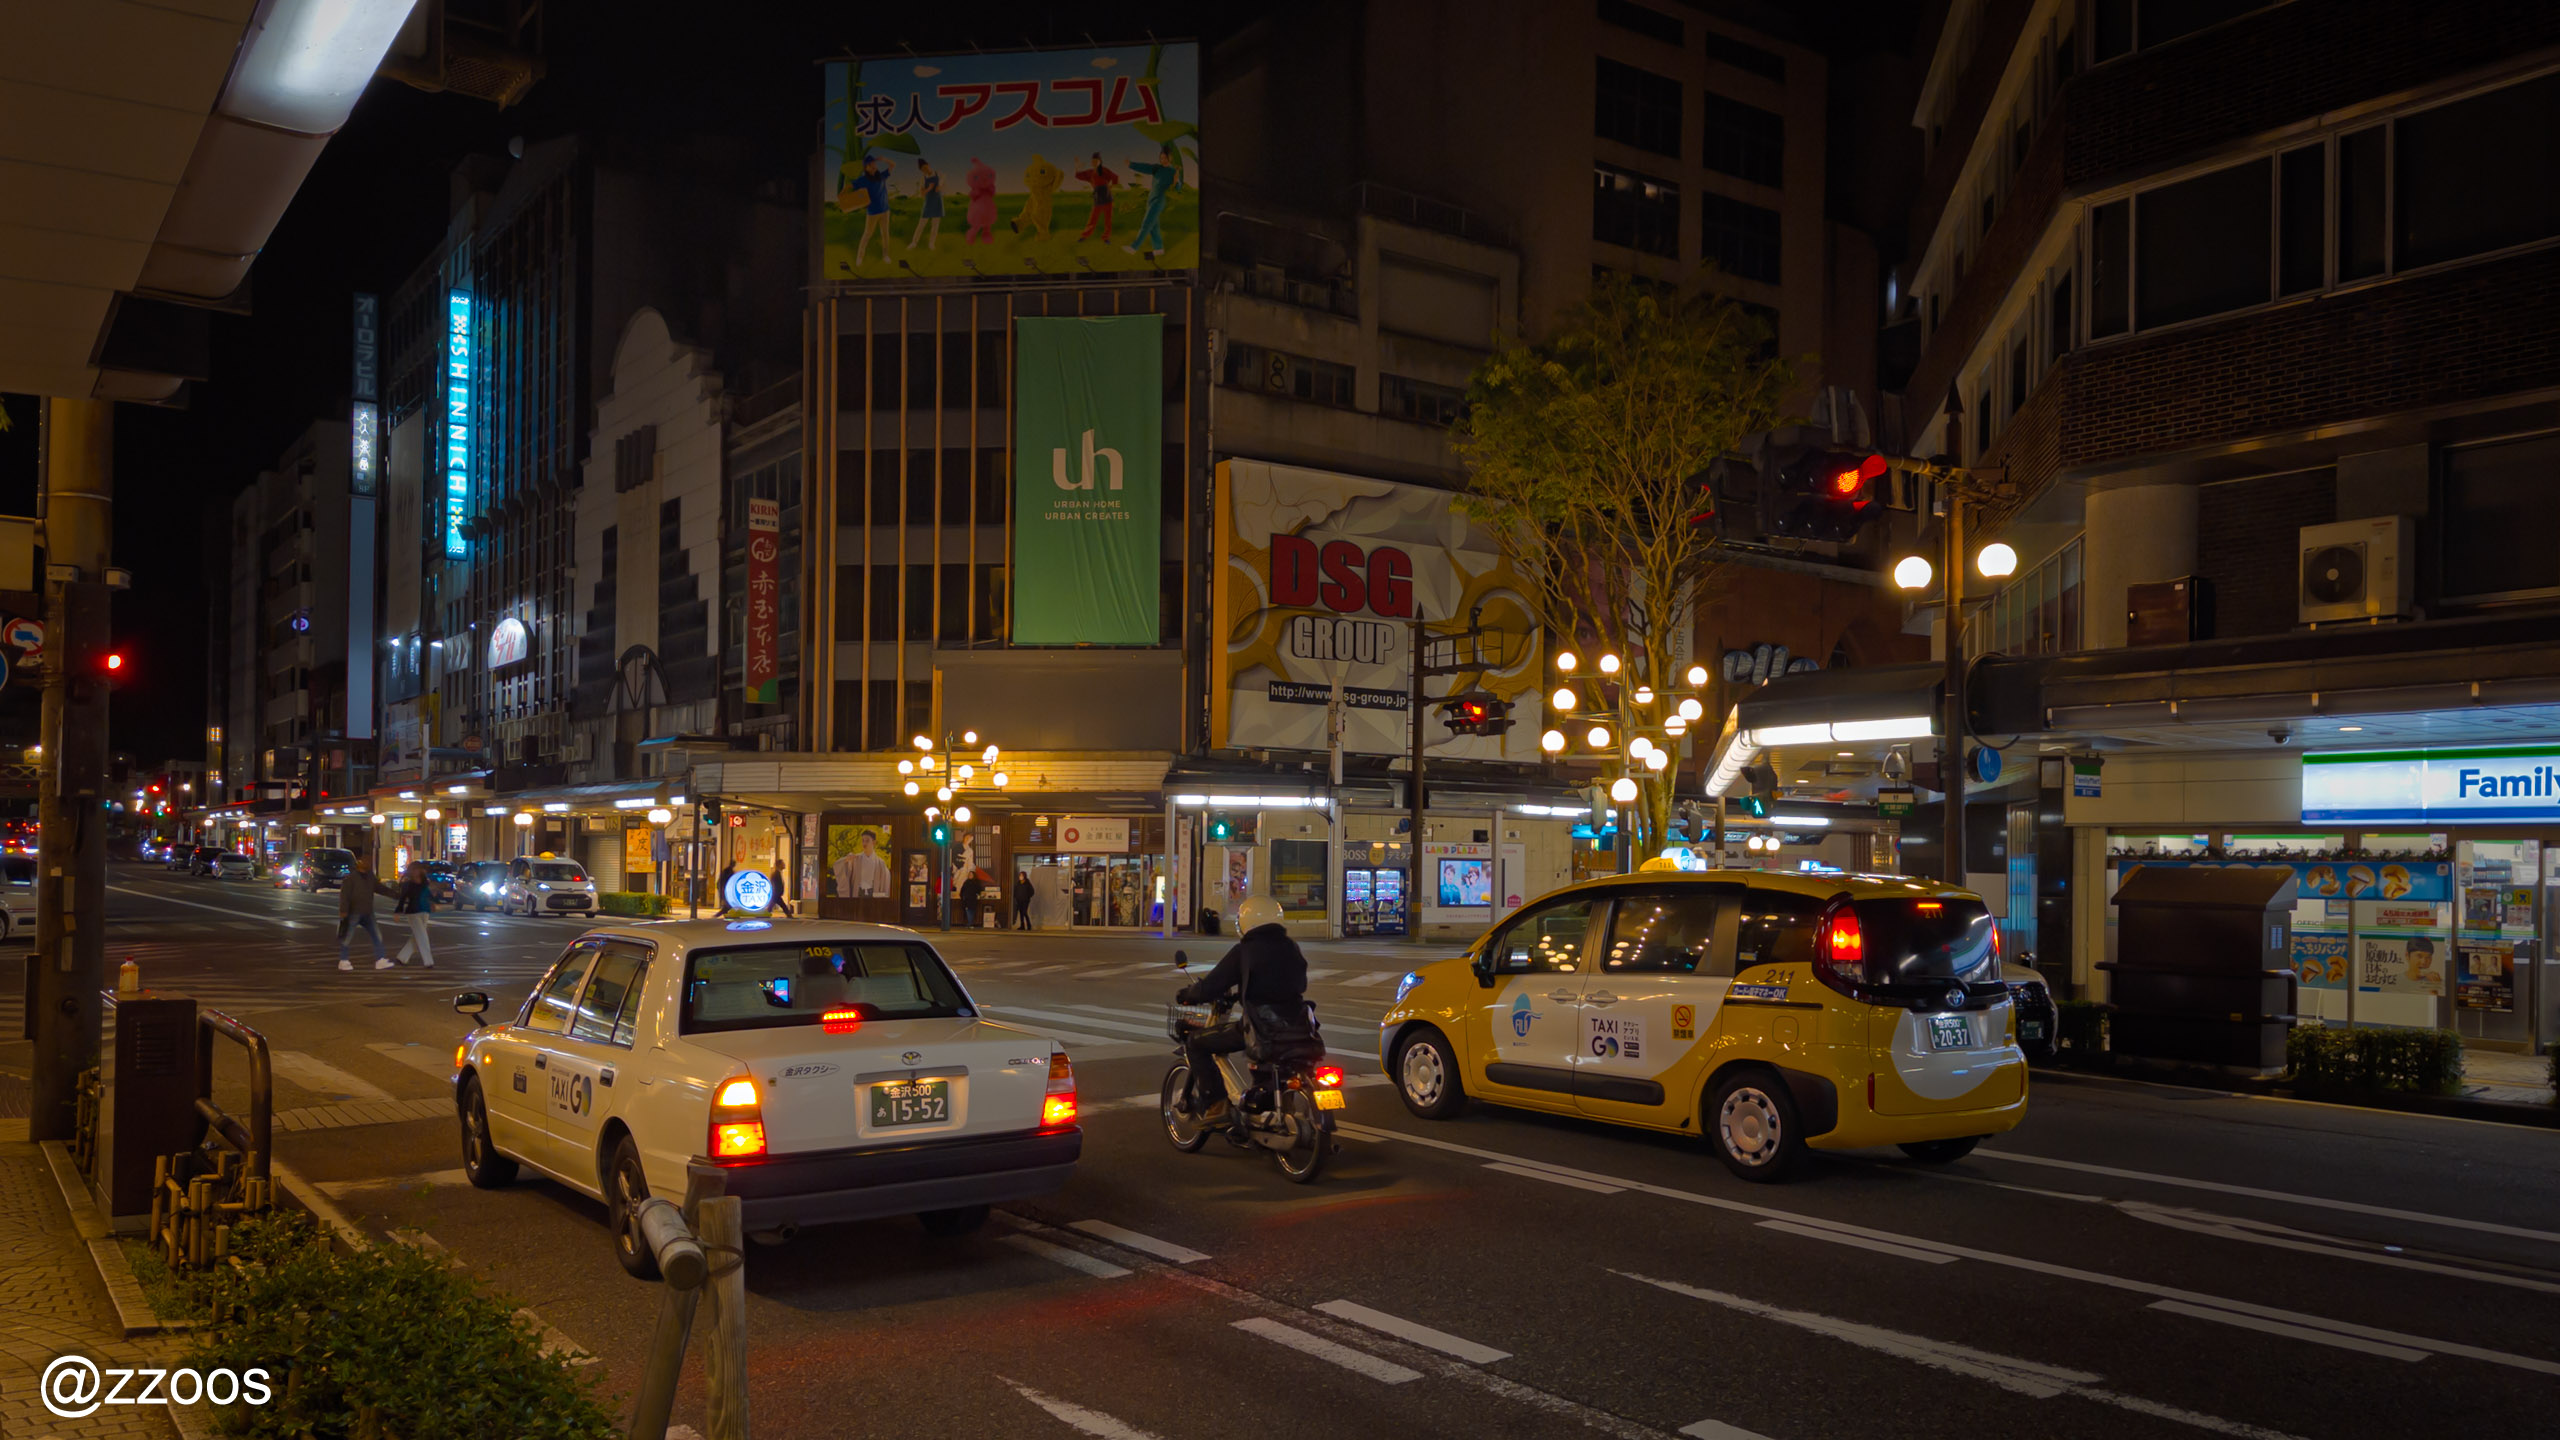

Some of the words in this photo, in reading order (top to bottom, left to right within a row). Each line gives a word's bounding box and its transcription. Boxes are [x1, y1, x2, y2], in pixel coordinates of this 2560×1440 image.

[856, 76, 1163, 135] 求人アスコム
[448, 345, 468, 502] SHINNICHI
[1053, 428, 1124, 490] uh
[750, 503, 778, 517] KIRIN
[1054, 500, 1090, 508] URBAN
[1094, 500, 1121, 508] HOME
[1045, 512, 1081, 520] URBAN
[1085, 511, 1130, 520] CREATES
[1270, 533, 1413, 618] DSG
[1291, 614, 1396, 665] GROUP
[1270, 684, 1408, 708] http://wwwsg-group.jp
[1425, 845, 1449, 854] LAND
[1451, 845, 1478, 855] PLAZA
[741, 881, 767, 894] 金沢
[742, 895, 766, 903] TAXI
[804, 946, 833, 958] 103
[1764, 969, 1795, 985] 211
[1591, 1018, 1618, 1034] TAXI
[1623, 1028, 1640, 1036] アプリ
[1592, 1036, 1619, 1058] GO
[785, 1065, 837, 1077] 金沢タクシー
[551, 1076, 569, 1102] TAXI
[570, 1073, 592, 1117] GO
[876, 1106, 887, 1118] あ
[892, 1097, 945, 1122] 15-52
